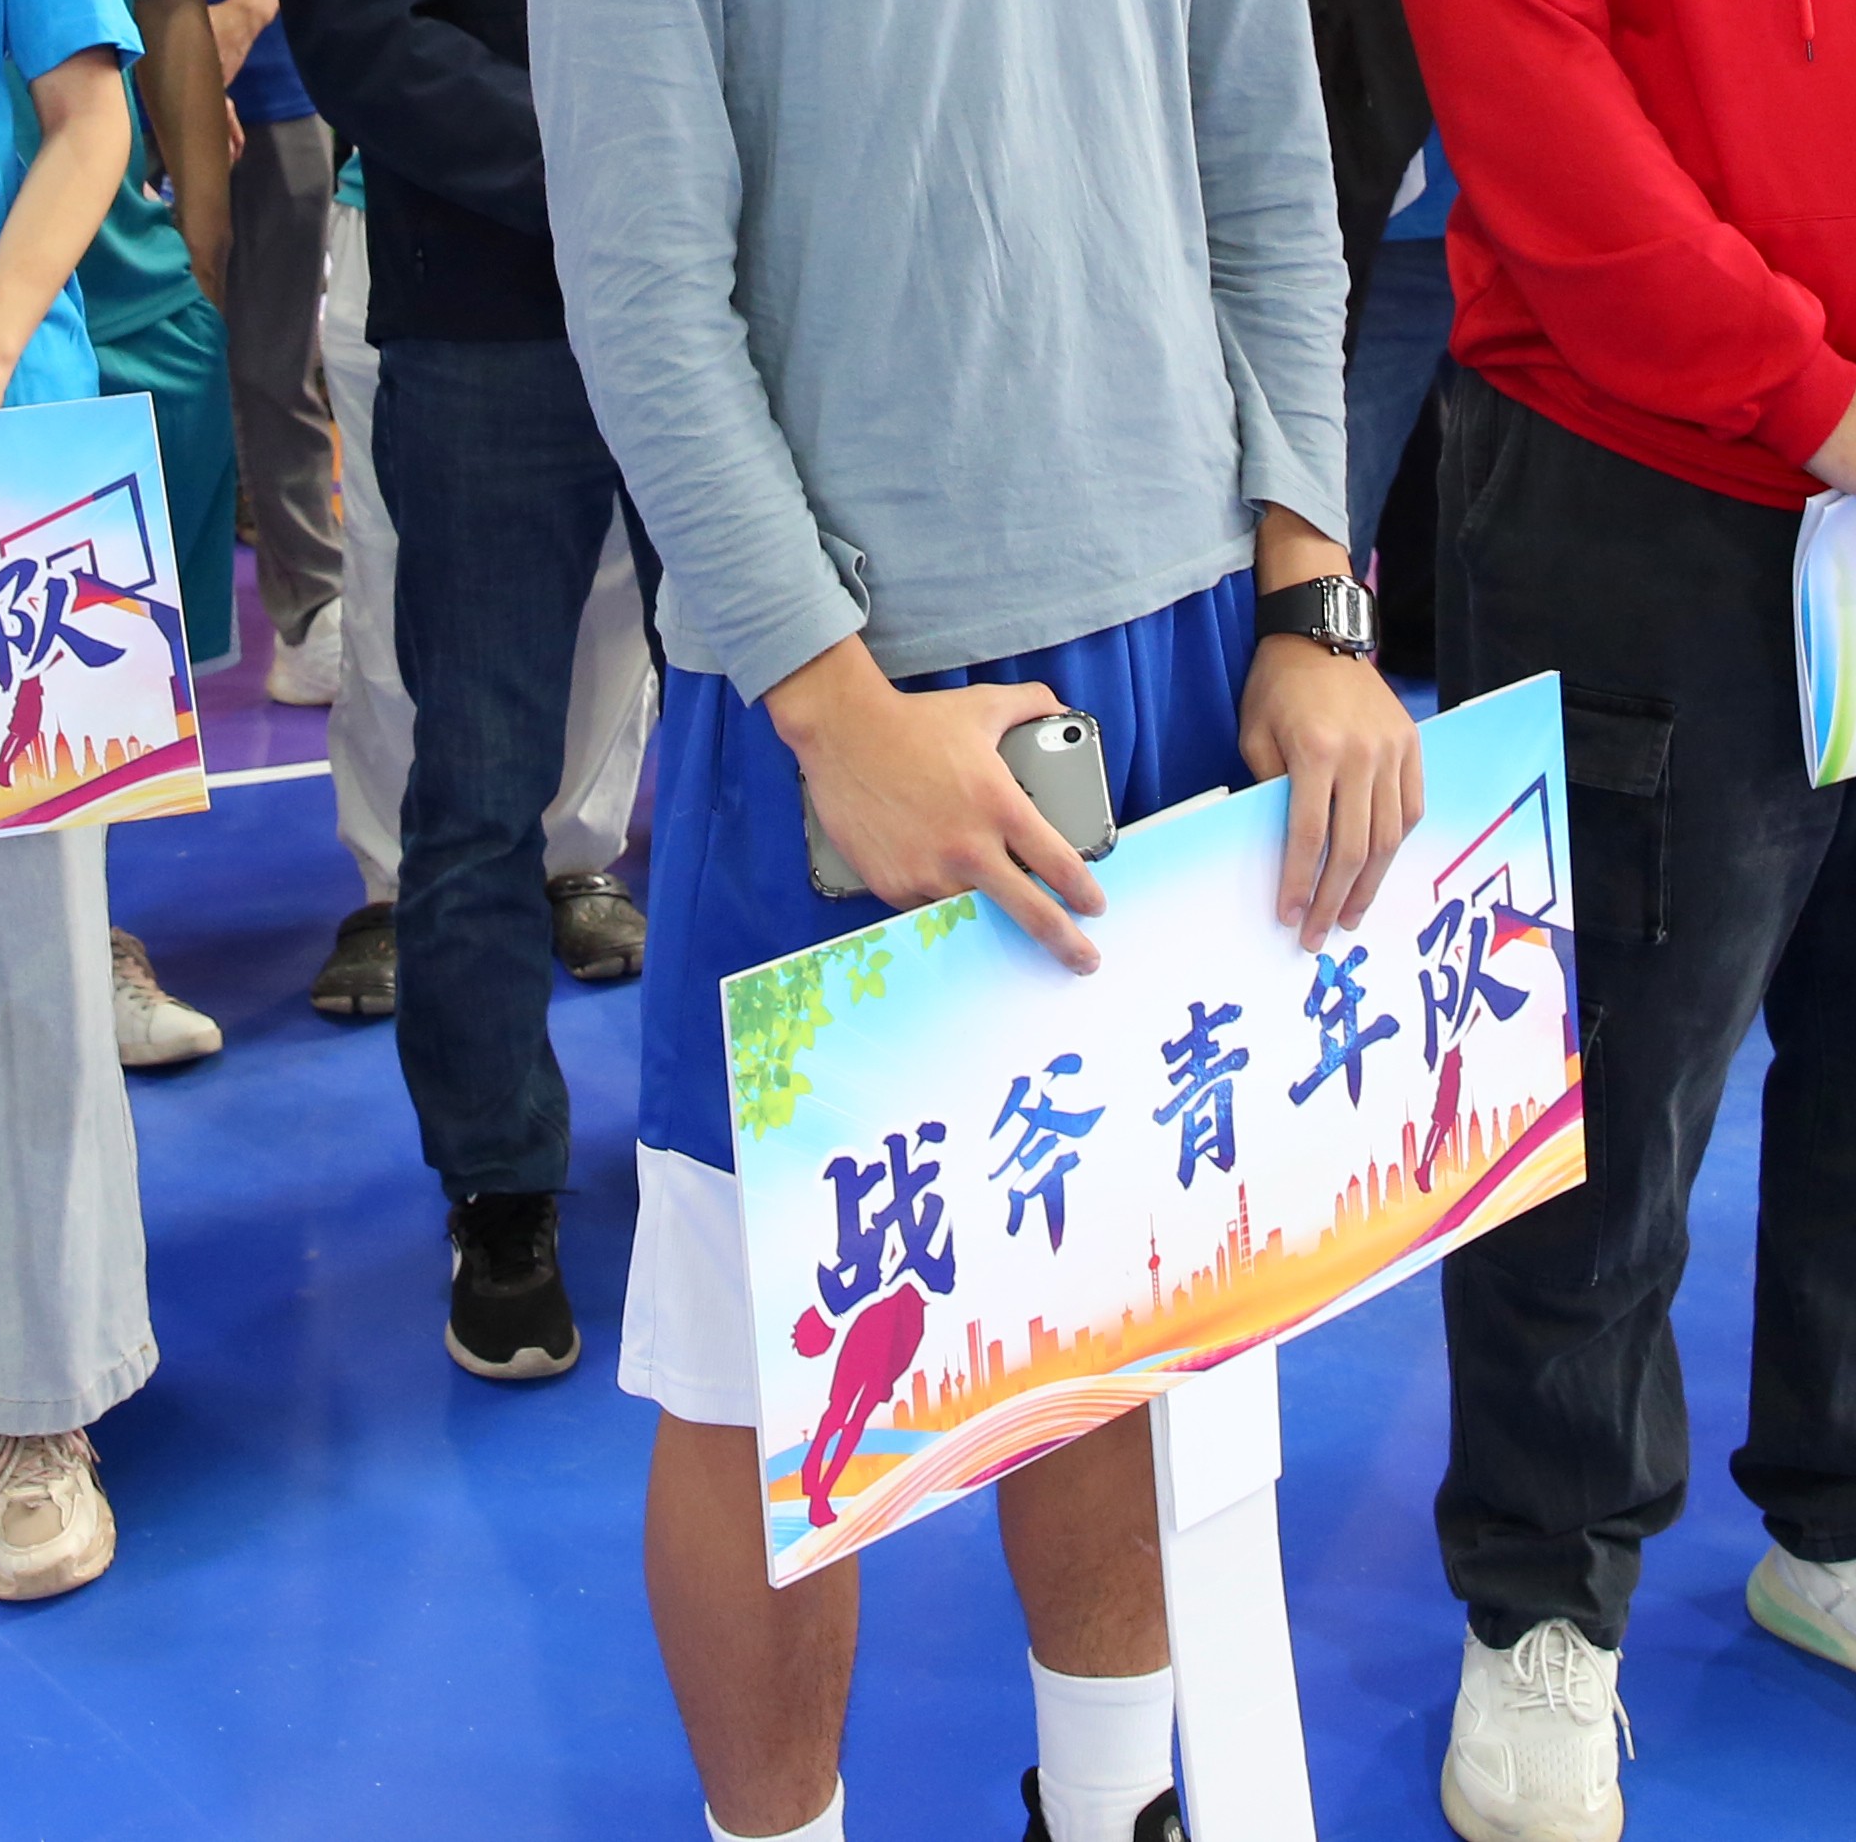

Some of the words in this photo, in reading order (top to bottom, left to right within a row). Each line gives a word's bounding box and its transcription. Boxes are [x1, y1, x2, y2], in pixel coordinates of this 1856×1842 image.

[816, 896, 1534, 1317] 战斧青年队
